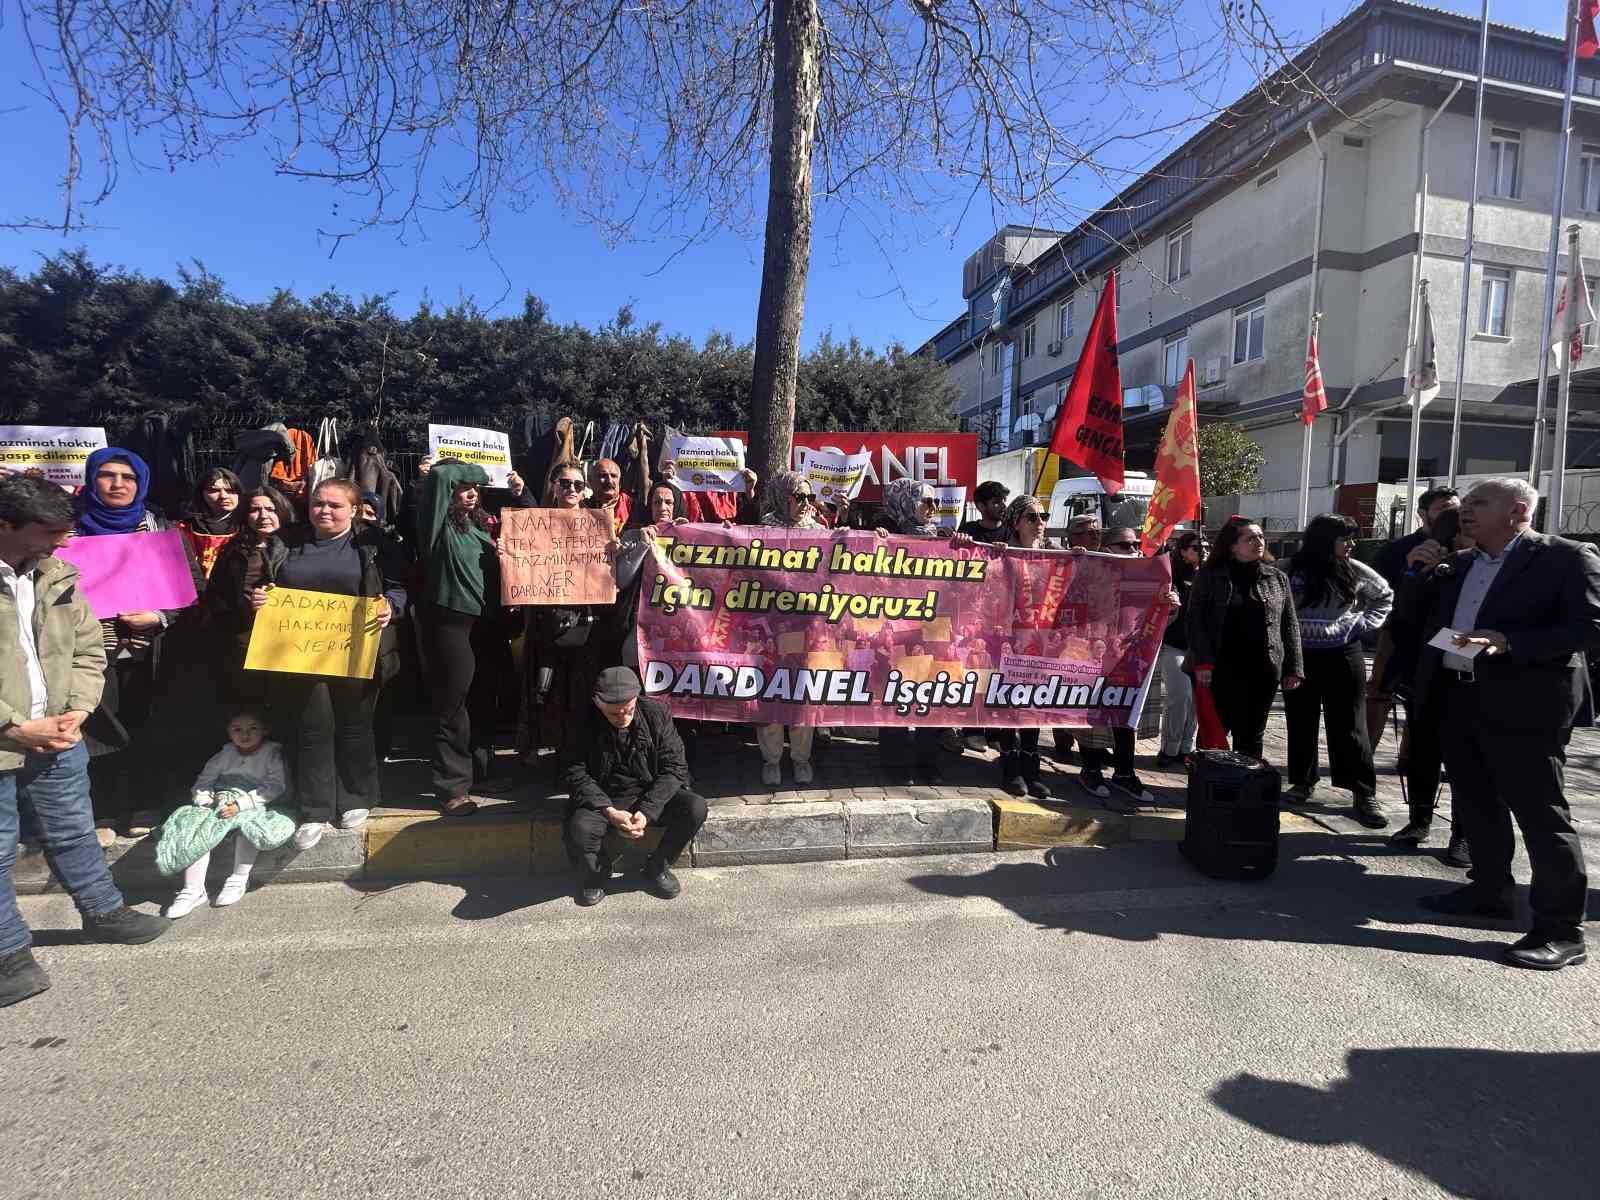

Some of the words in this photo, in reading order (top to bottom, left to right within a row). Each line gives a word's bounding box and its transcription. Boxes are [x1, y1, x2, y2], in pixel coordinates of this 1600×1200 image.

[0, 439, 55, 448] azminat
[57, 439, 98, 448] haktır
[436, 436, 481, 448] Tazminat
[34, 451, 87, 460] edileme
[439, 450, 463, 460] gasp
[464, 450, 506, 463] edilemez!
[676, 447, 715, 456] Tazminat
[678, 460, 698, 469] gasp
[810, 460, 847, 473] Tazminat
[652, 537, 822, 571] Tazminat
[829, 543, 988, 582] hakkımız
[539, 569, 575, 588] VER
[266, 590, 348, 613] SADAKA
[648, 573, 715, 617] için
[723, 580, 939, 624] direniyoruz!
[644, 660, 872, 705] DARDANEL
[882, 671, 978, 716] işçisi
[984, 674, 1142, 708] kadınlar
